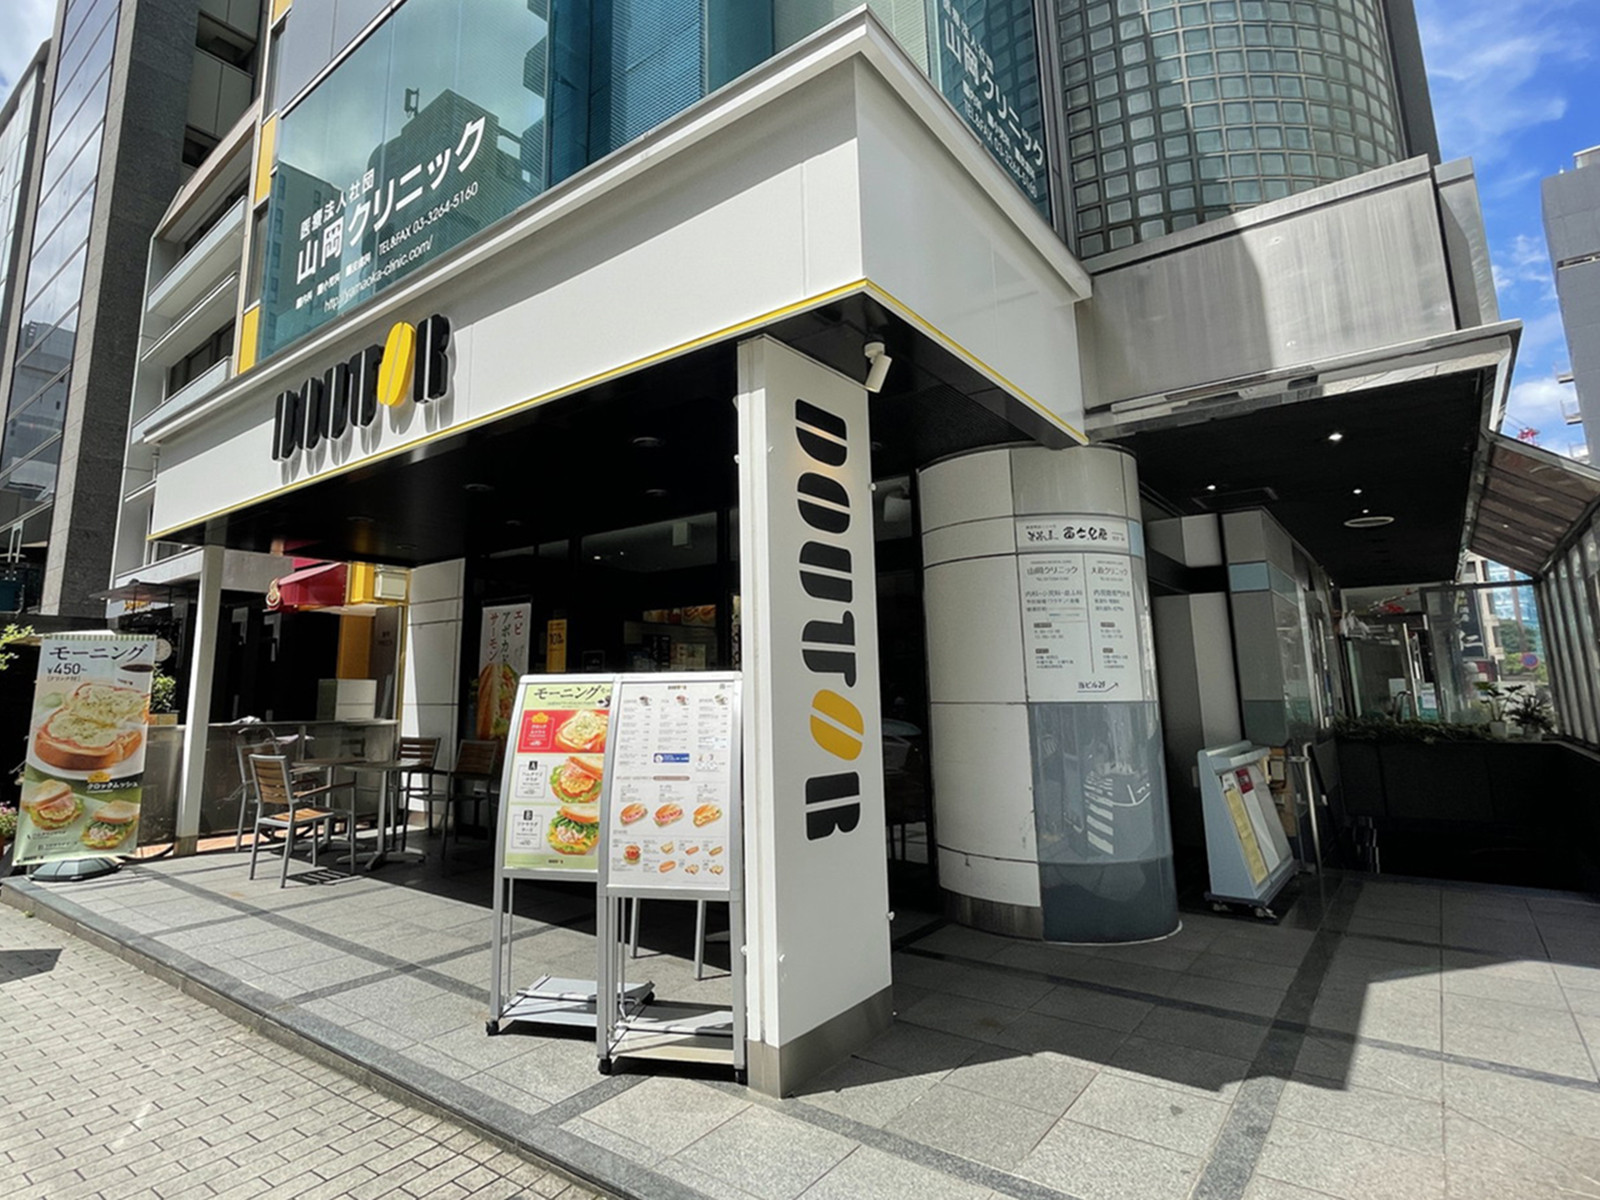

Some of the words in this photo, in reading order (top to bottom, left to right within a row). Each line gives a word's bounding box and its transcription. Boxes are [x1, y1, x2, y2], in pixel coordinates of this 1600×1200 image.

[296, 116, 486, 285] 山岡クリニック
[300, 167, 375, 241] 医療法人社団
[412, 181, 479, 235] 03-3264-5160
[272, 314, 450, 461] DOUTOR
[487, 612, 500, 662] サーモン
[513, 609, 525, 636] エビ
[795, 398, 864, 841] DOUTOR
[49, 643, 149, 662] モーニング
[533, 685, 602, 700] モーニング
[86, 781, 139, 791] クロックムッシュ
